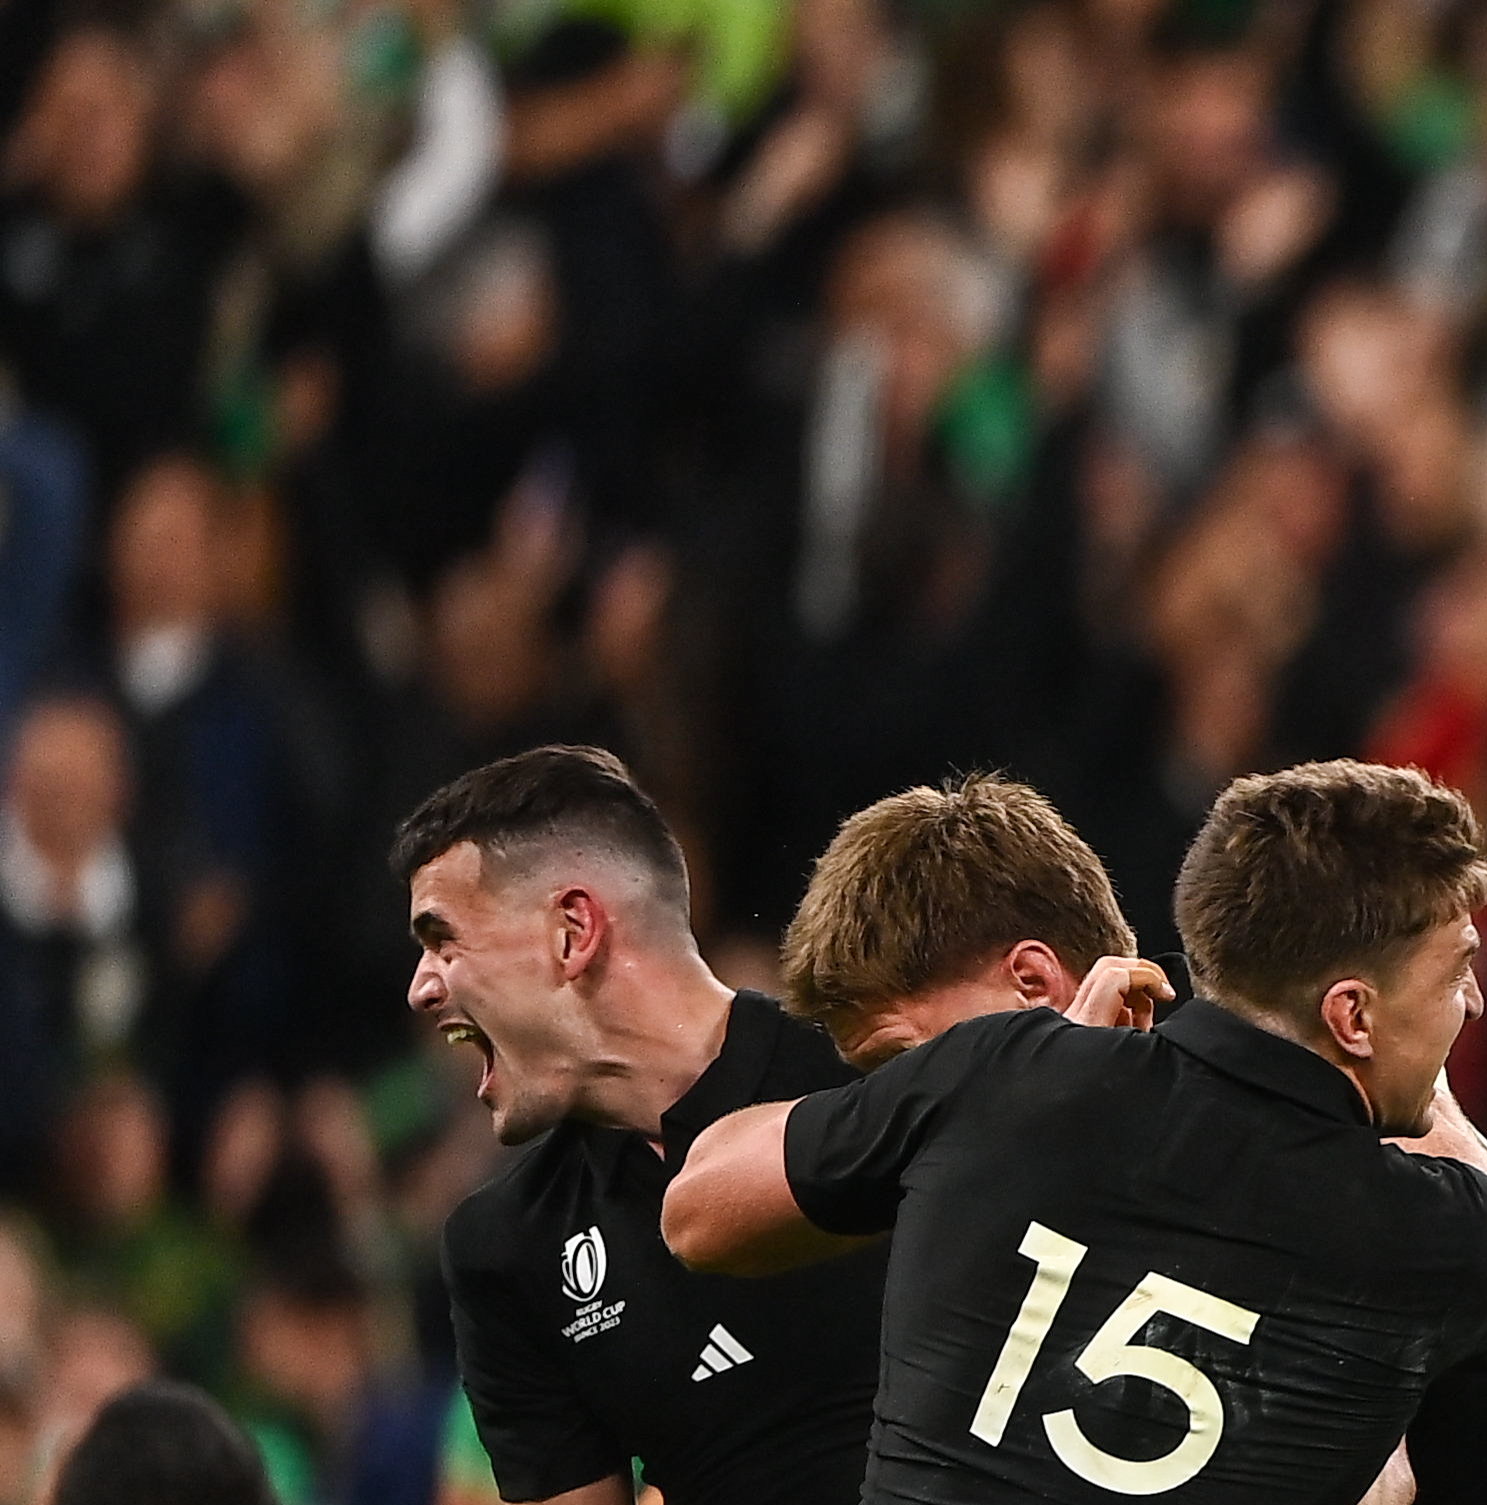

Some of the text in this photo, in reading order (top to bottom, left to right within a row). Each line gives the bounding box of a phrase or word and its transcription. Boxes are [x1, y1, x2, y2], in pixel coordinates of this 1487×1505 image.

[561, 1300, 626, 1337] WORLD CUP
[969, 1221, 1261, 1495] 15
